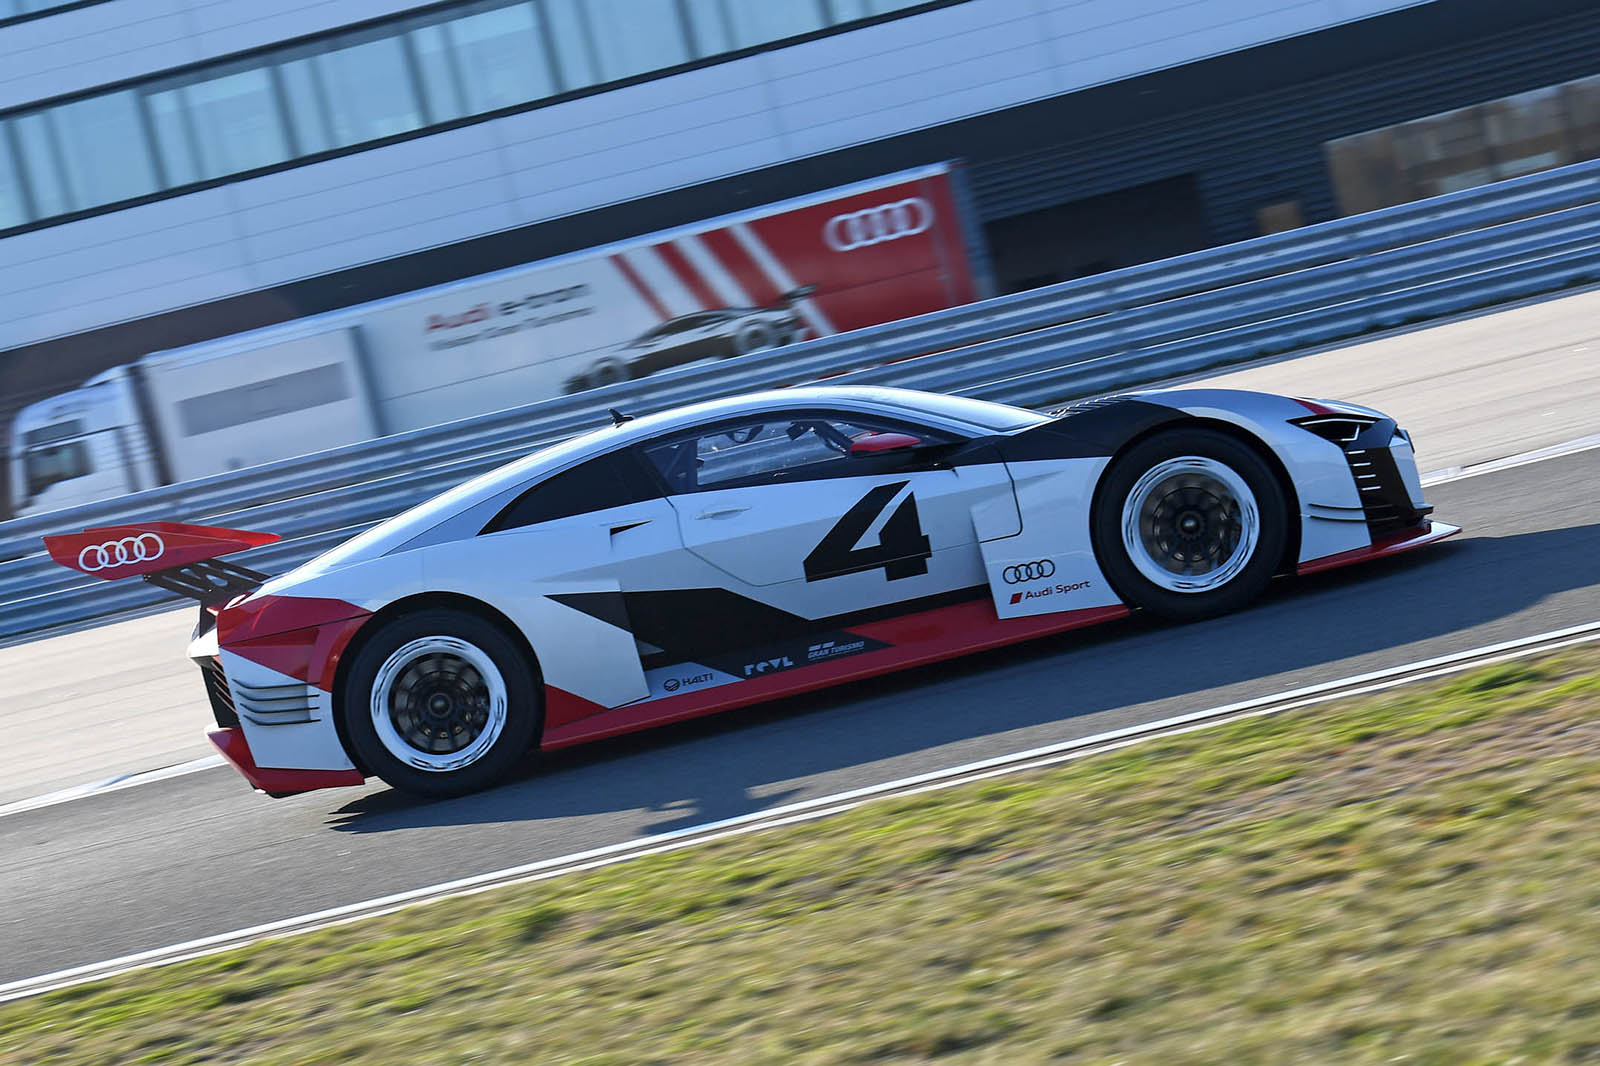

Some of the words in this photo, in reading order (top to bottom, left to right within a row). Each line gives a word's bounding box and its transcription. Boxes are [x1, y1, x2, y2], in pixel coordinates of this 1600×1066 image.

[425, 301, 489, 332] Audi
[803, 480, 932, 583] 4
[1025, 587, 1053, 600] Audi
[1055, 581, 1091, 594] Sport
[808, 647, 831, 659] GRAN
[831, 641, 865, 654] TURISMO
[682, 672, 713, 687] HALTI
